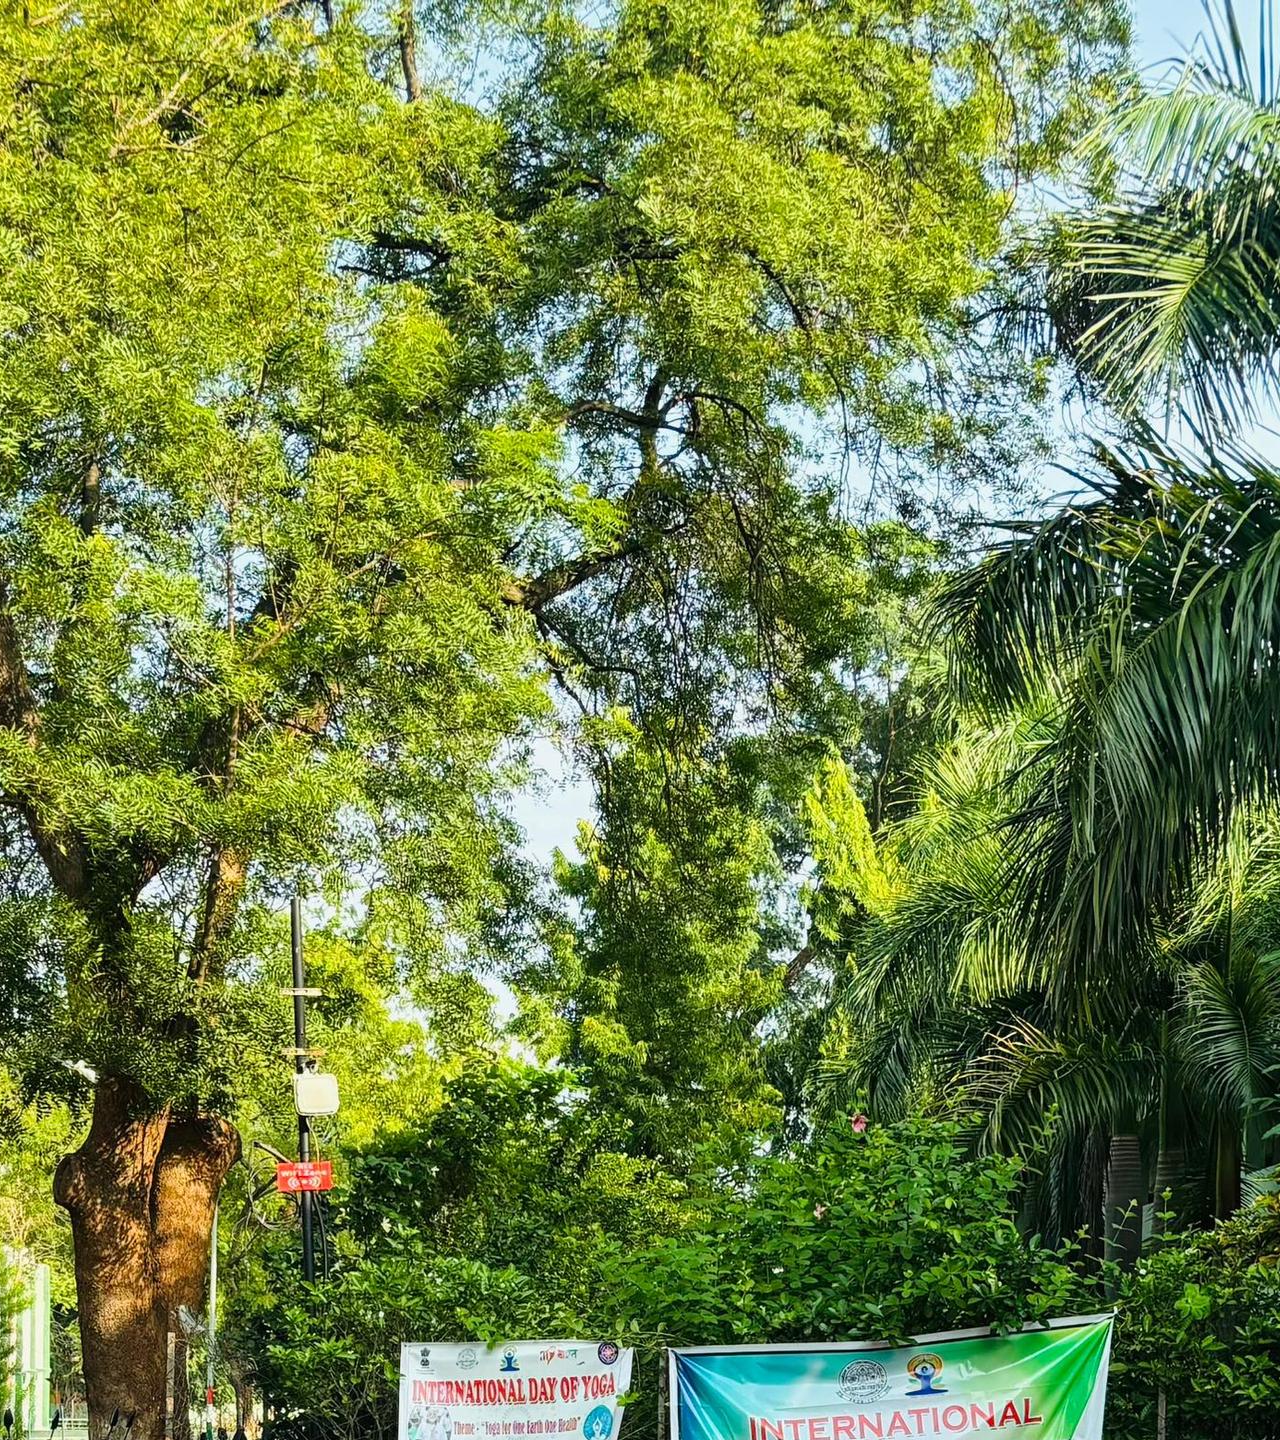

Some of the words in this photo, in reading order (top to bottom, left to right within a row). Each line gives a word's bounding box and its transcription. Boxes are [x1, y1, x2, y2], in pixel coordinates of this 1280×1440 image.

[413, 1379, 526, 1406] INTERNATIONAL
[528, 1377, 557, 1405] DAY
[560, 1377, 579, 1402] OF
[582, 1372, 617, 1400] YOGA
[454, 1421, 475, 1435] Theme
